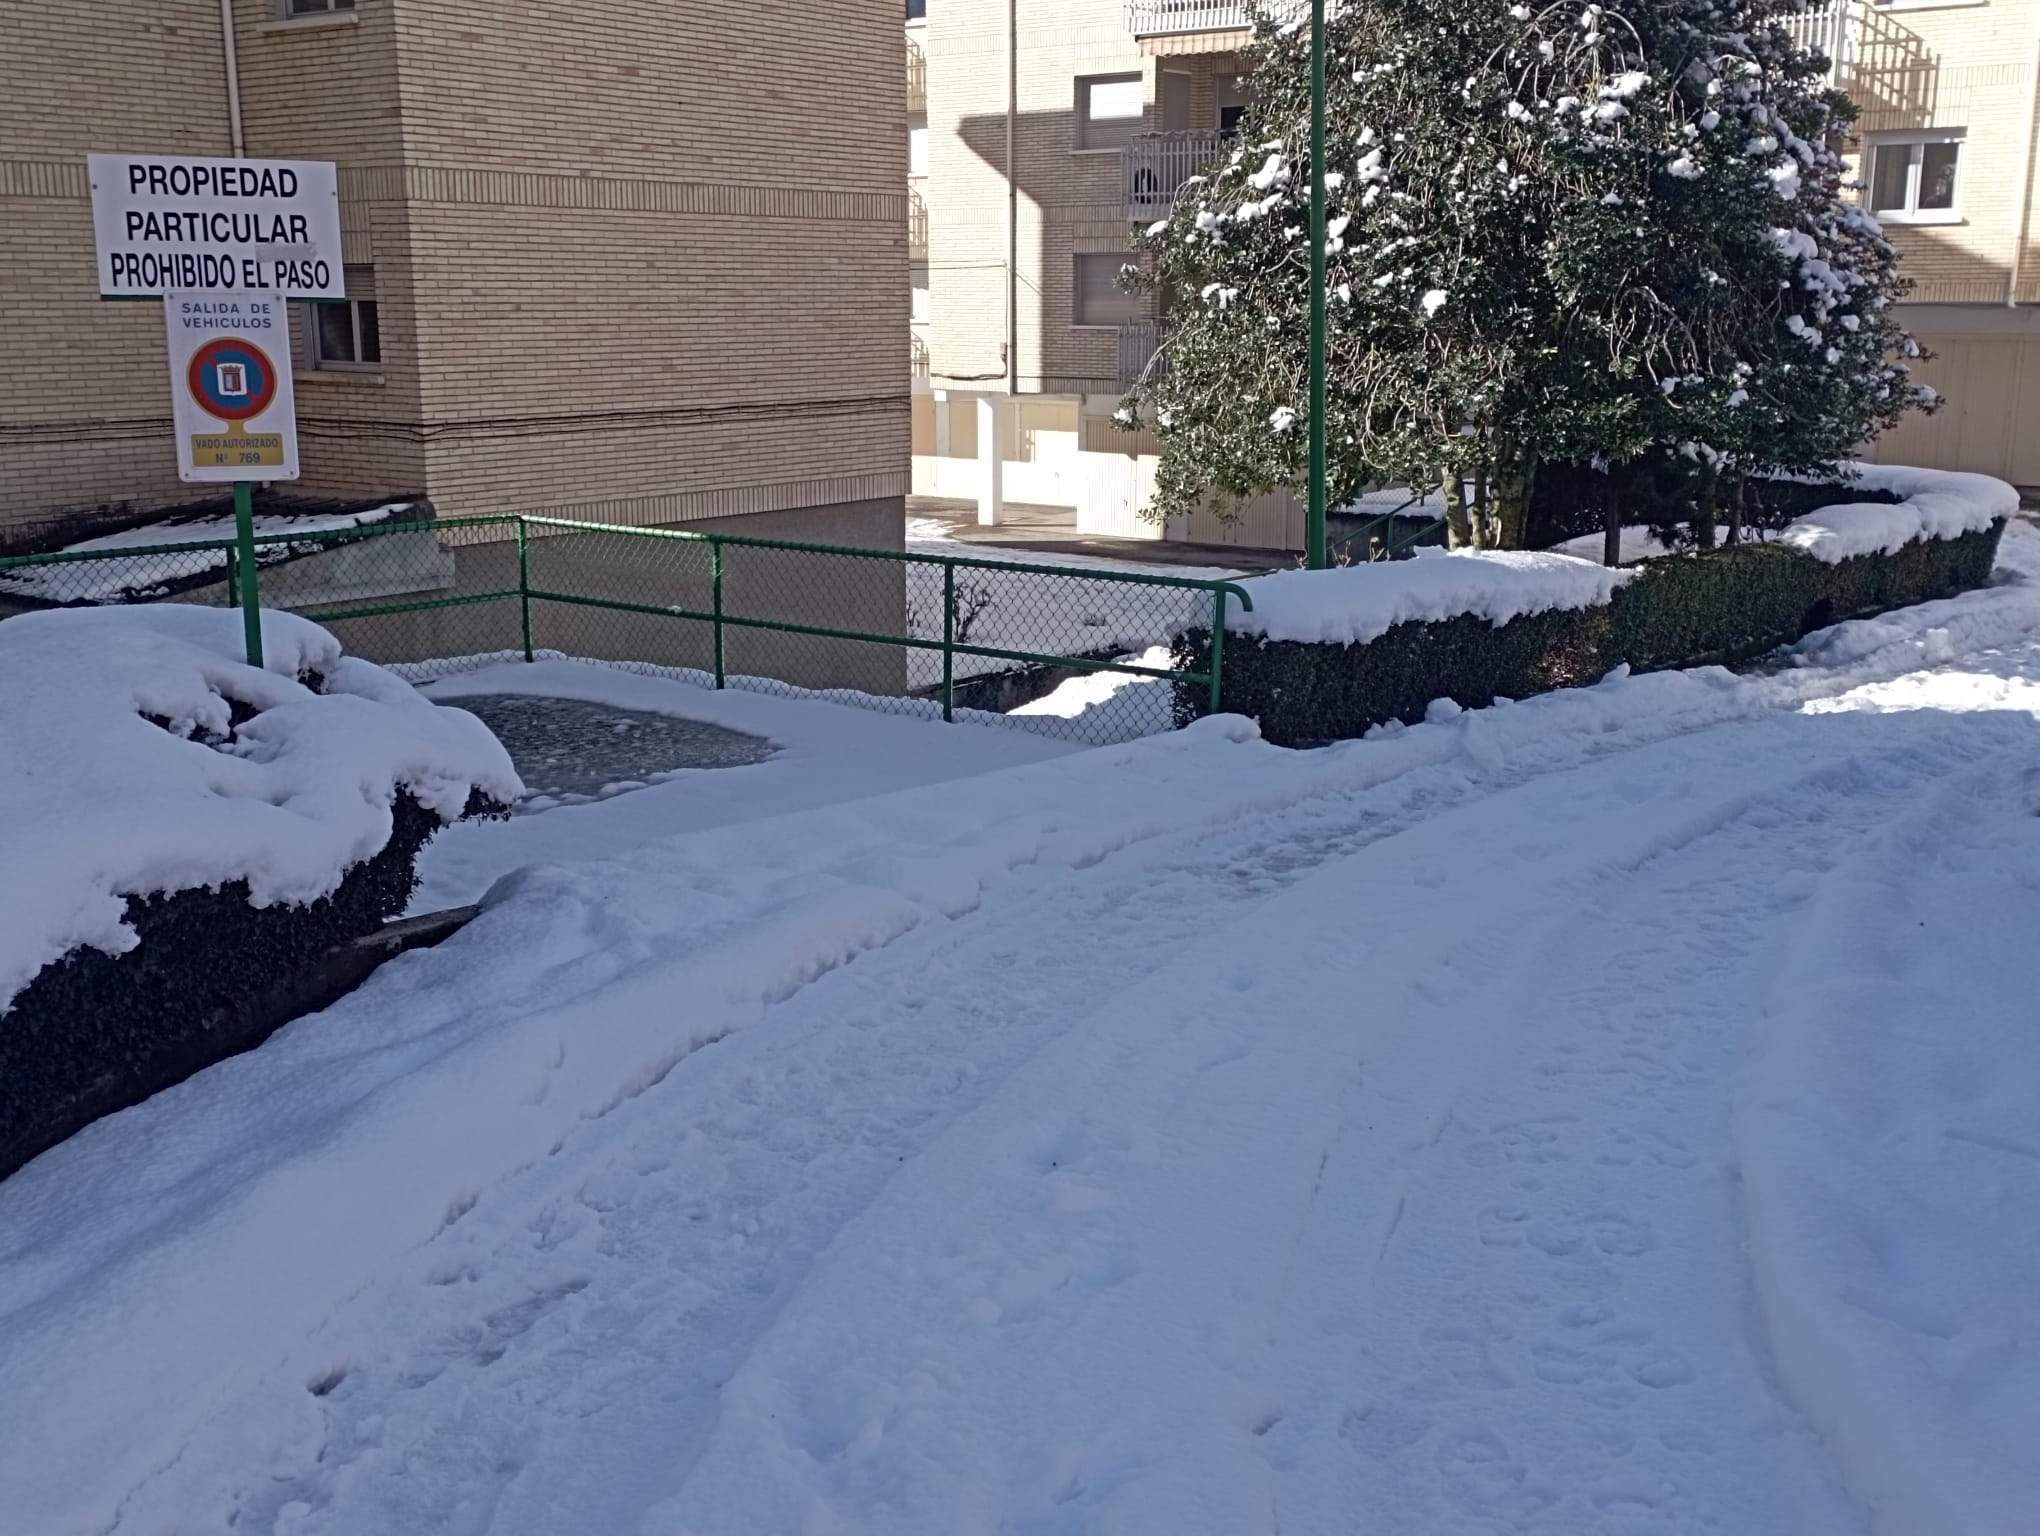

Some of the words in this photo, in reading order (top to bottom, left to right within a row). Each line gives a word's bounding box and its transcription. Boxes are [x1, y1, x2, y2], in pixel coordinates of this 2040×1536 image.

[129, 164, 298, 198] PROPIEDAD
[126, 211, 309, 244] PARTICULAR
[111, 253, 236, 288] PROHIBIDO
[243, 259, 269, 289] EL
[275, 260, 330, 290] PASO
[181, 303, 240, 314] SALIDA
[250, 303, 271, 314] DE
[182, 317, 272, 329] VEHICULOS
[195, 439, 221, 449] VADO
[222, 438, 279, 449] AUTORIZADO
[239, 452, 261, 464] 769
